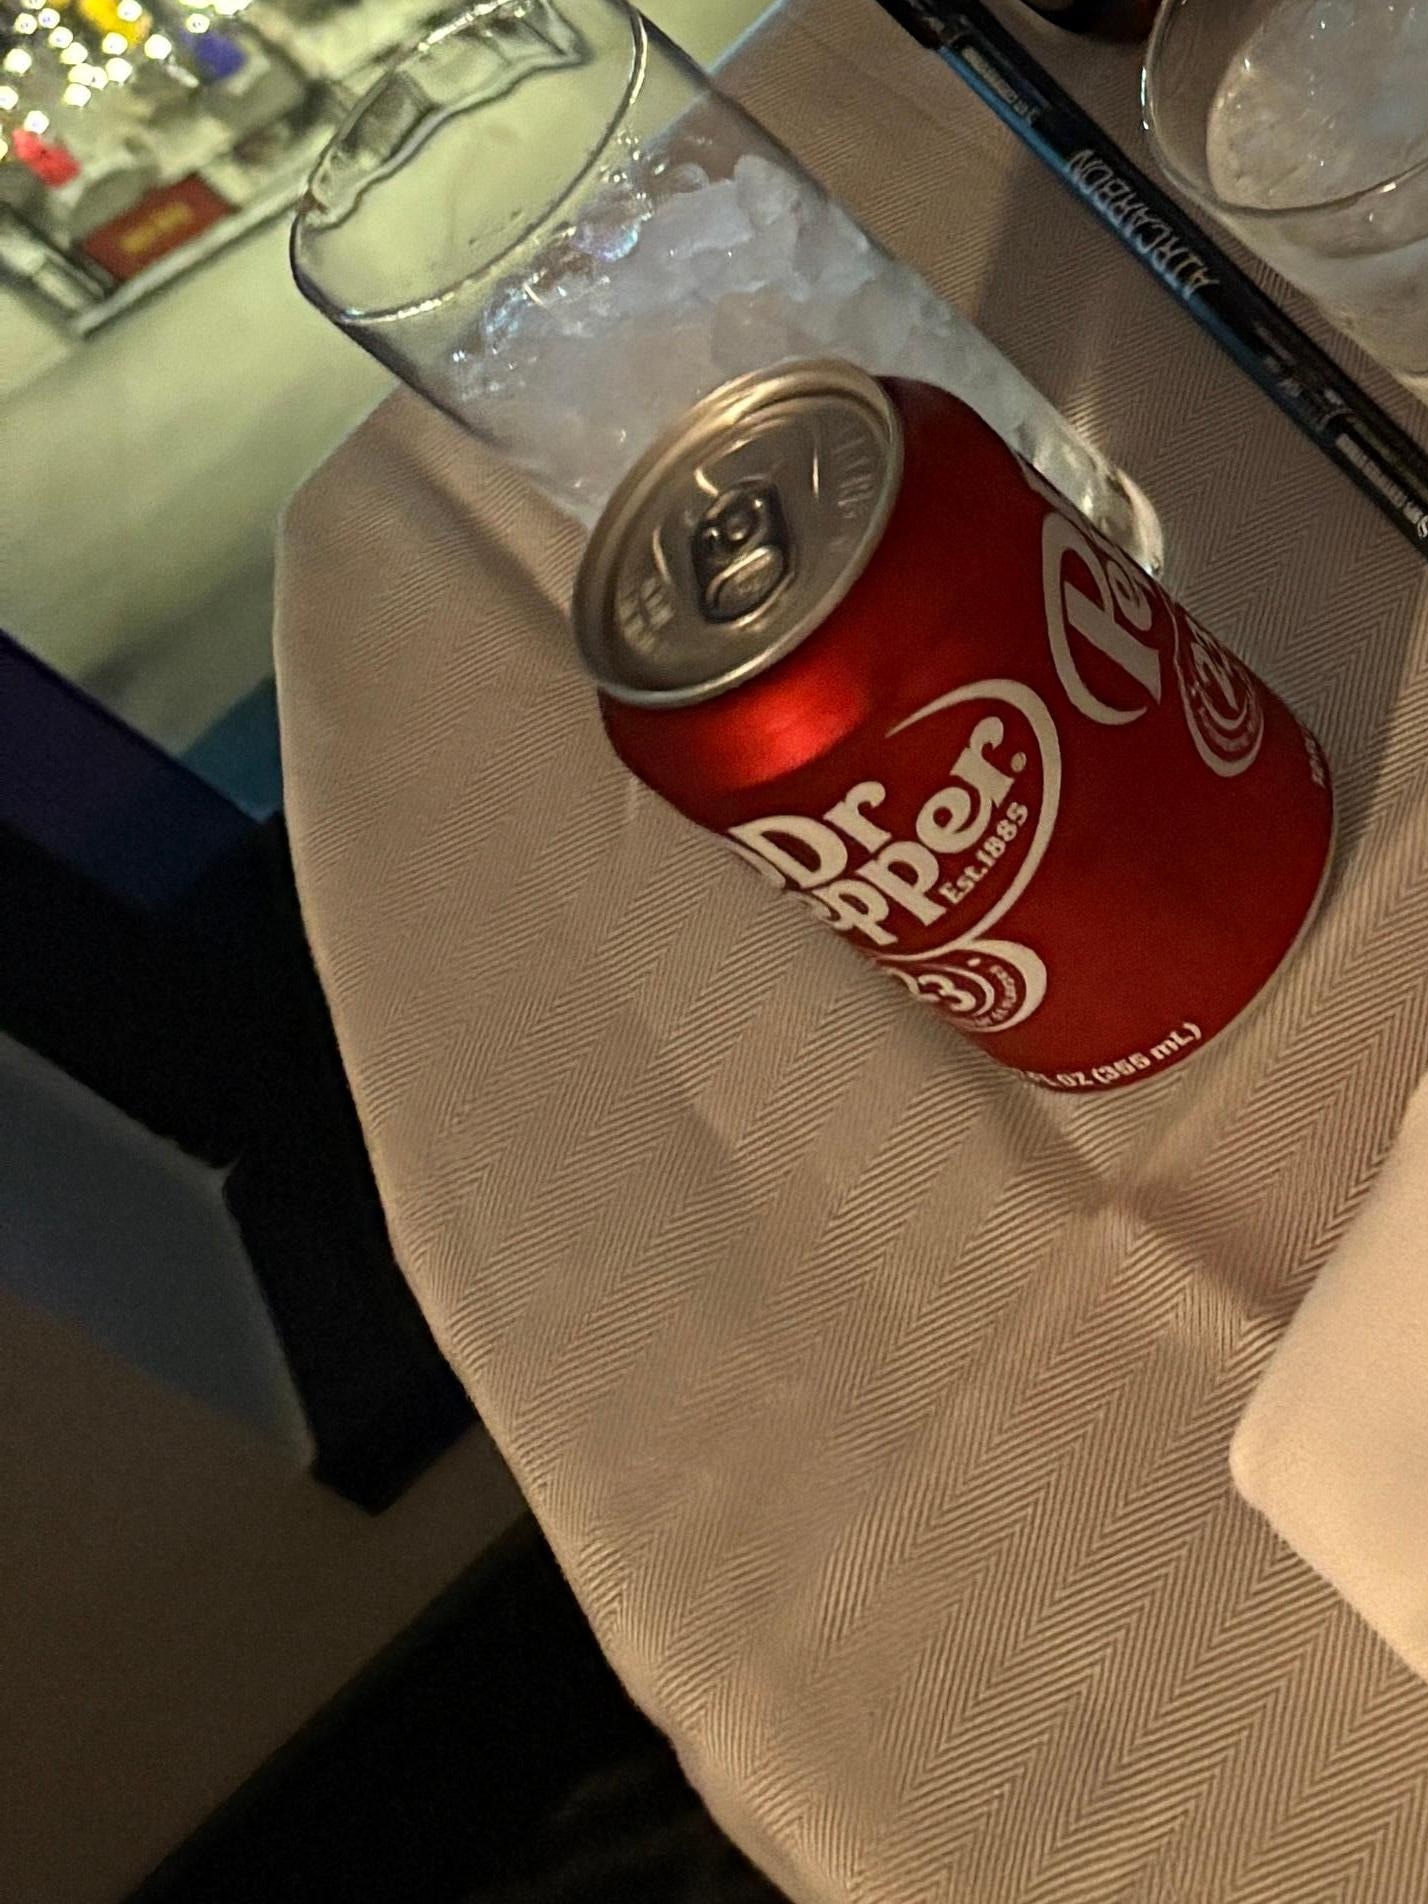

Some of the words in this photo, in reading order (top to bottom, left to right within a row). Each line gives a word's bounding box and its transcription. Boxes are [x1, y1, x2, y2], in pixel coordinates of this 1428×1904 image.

[1067, 148, 1221, 301] AIRCARBON
[727, 780, 893, 890] Dr
[800, 715, 1015, 946] pper
[1091, 1051, 1151, 1085] (355
[1149, 1021, 1203, 1061] mL)
